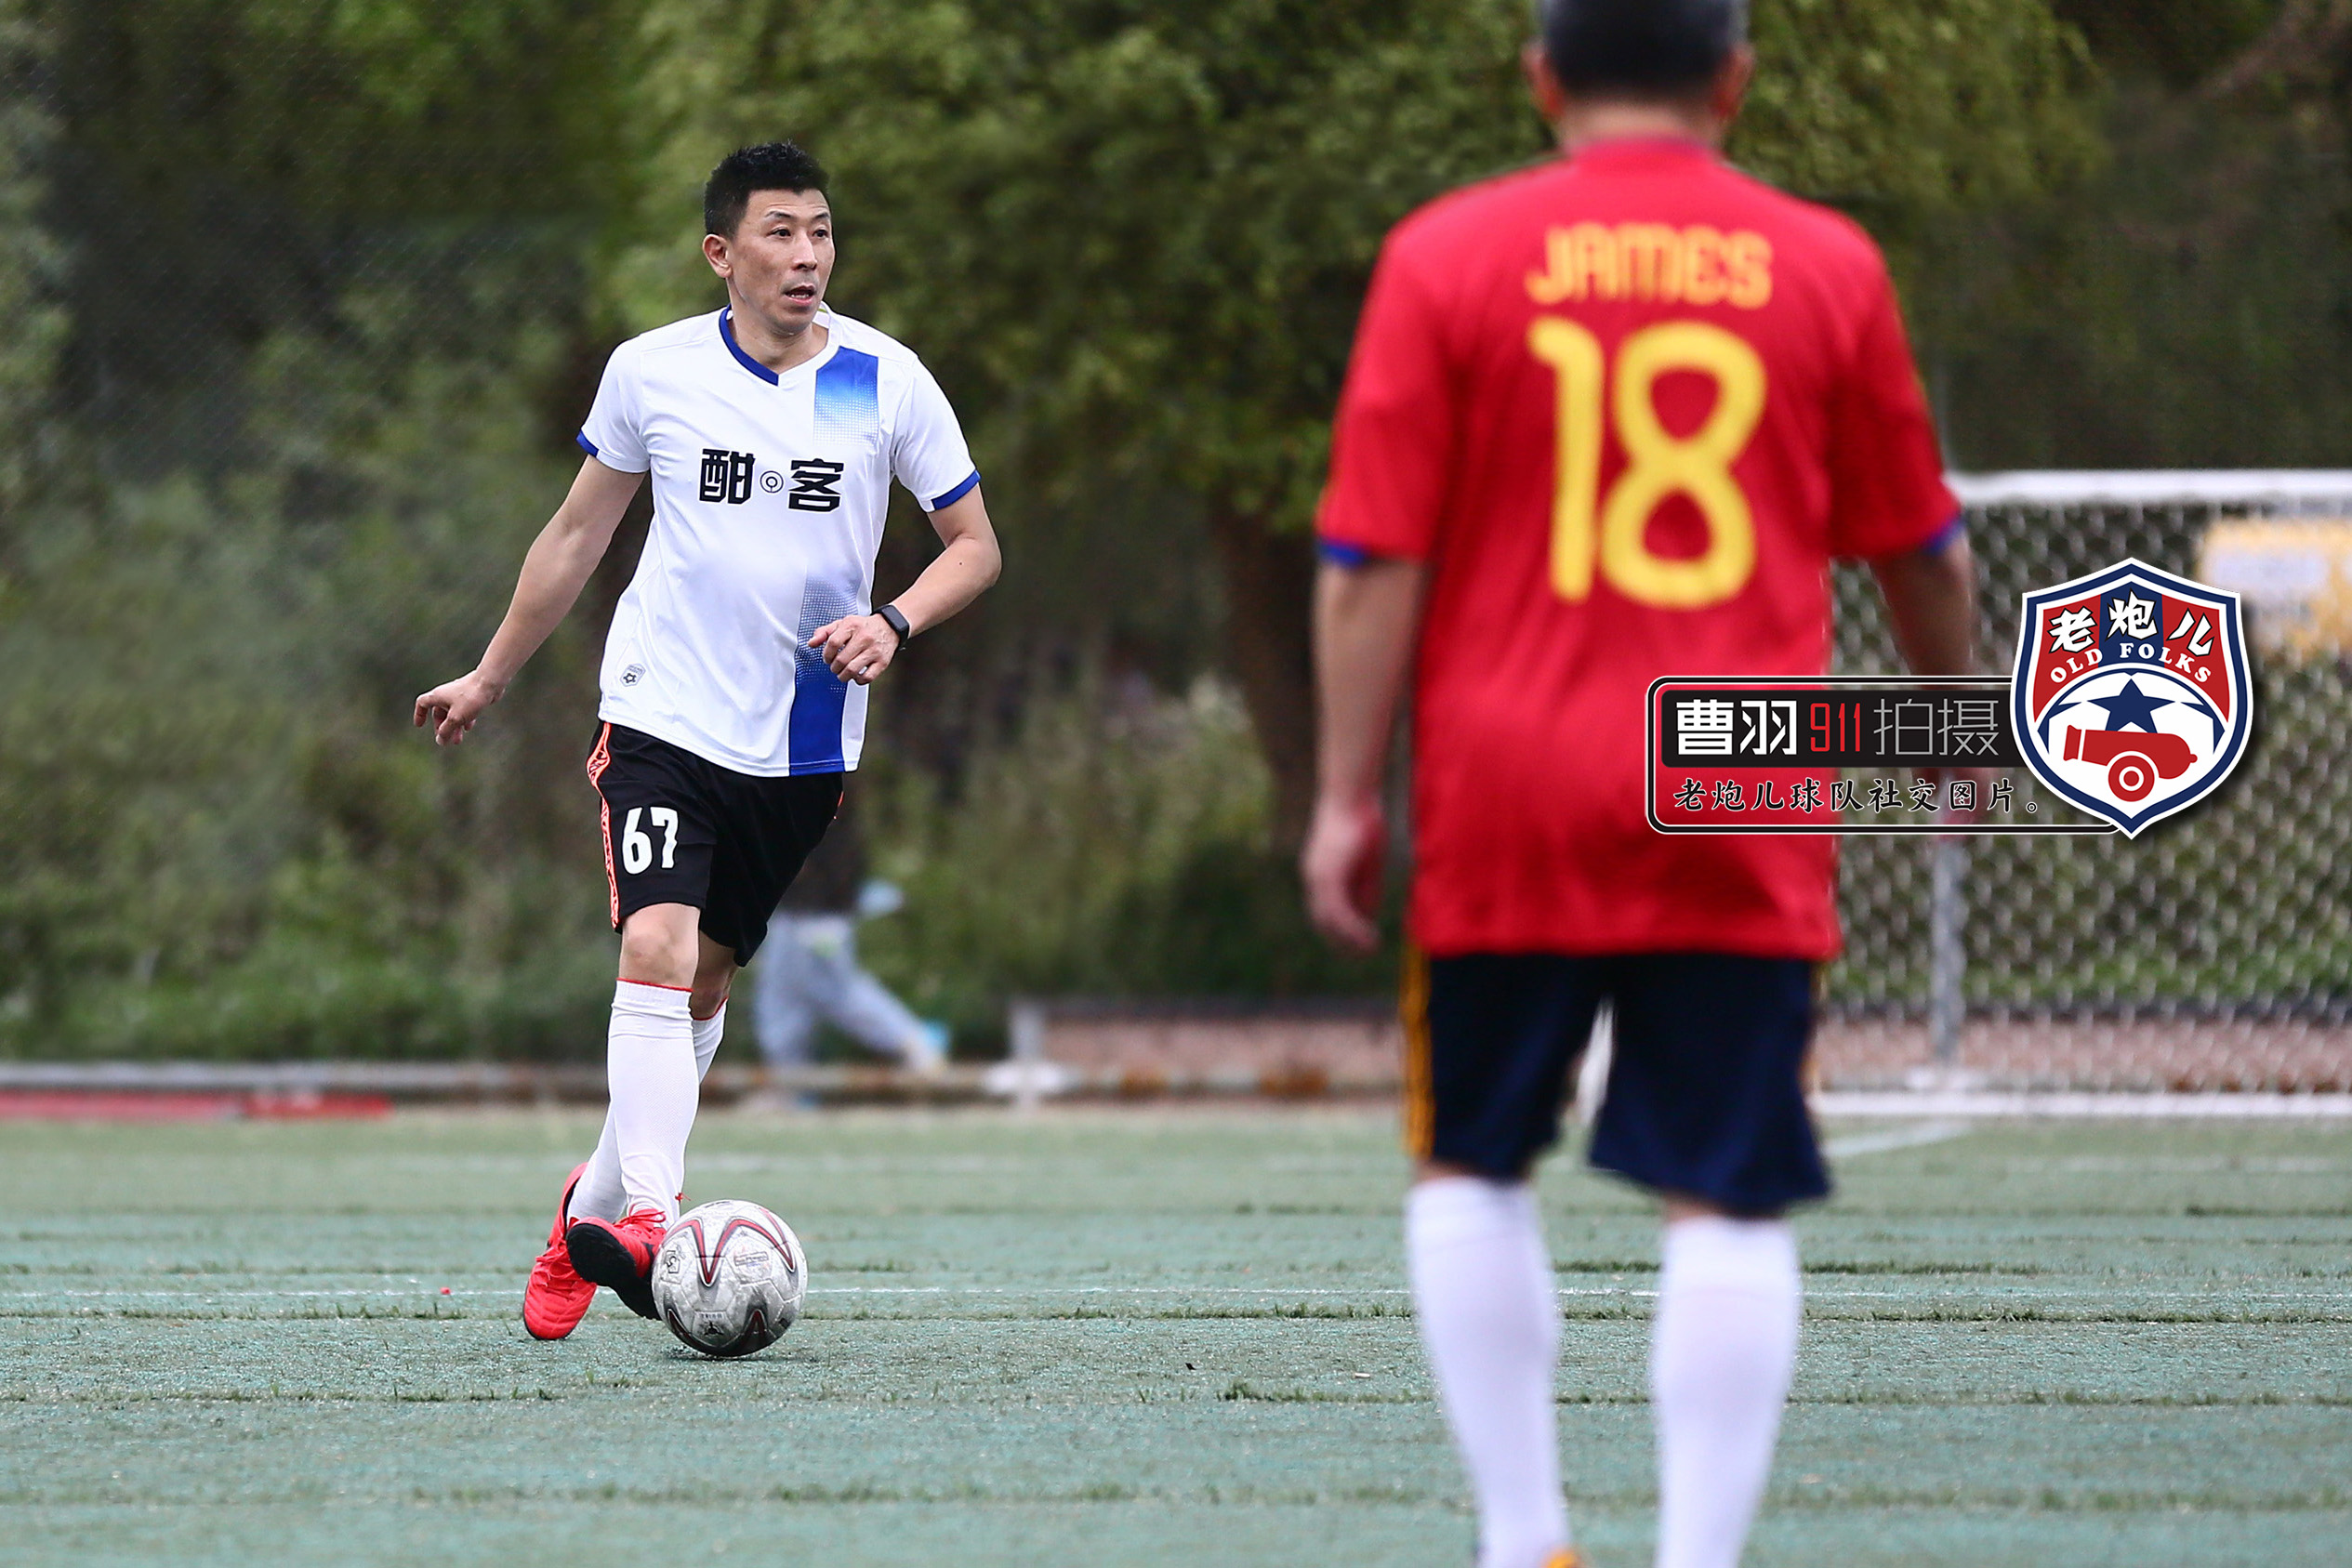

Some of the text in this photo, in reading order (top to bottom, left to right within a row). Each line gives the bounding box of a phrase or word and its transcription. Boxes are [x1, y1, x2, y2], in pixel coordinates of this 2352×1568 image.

[1526, 225, 1773, 309] JAMES
[1529, 320, 1767, 609] 18
[622, 806, 679, 875] 67
